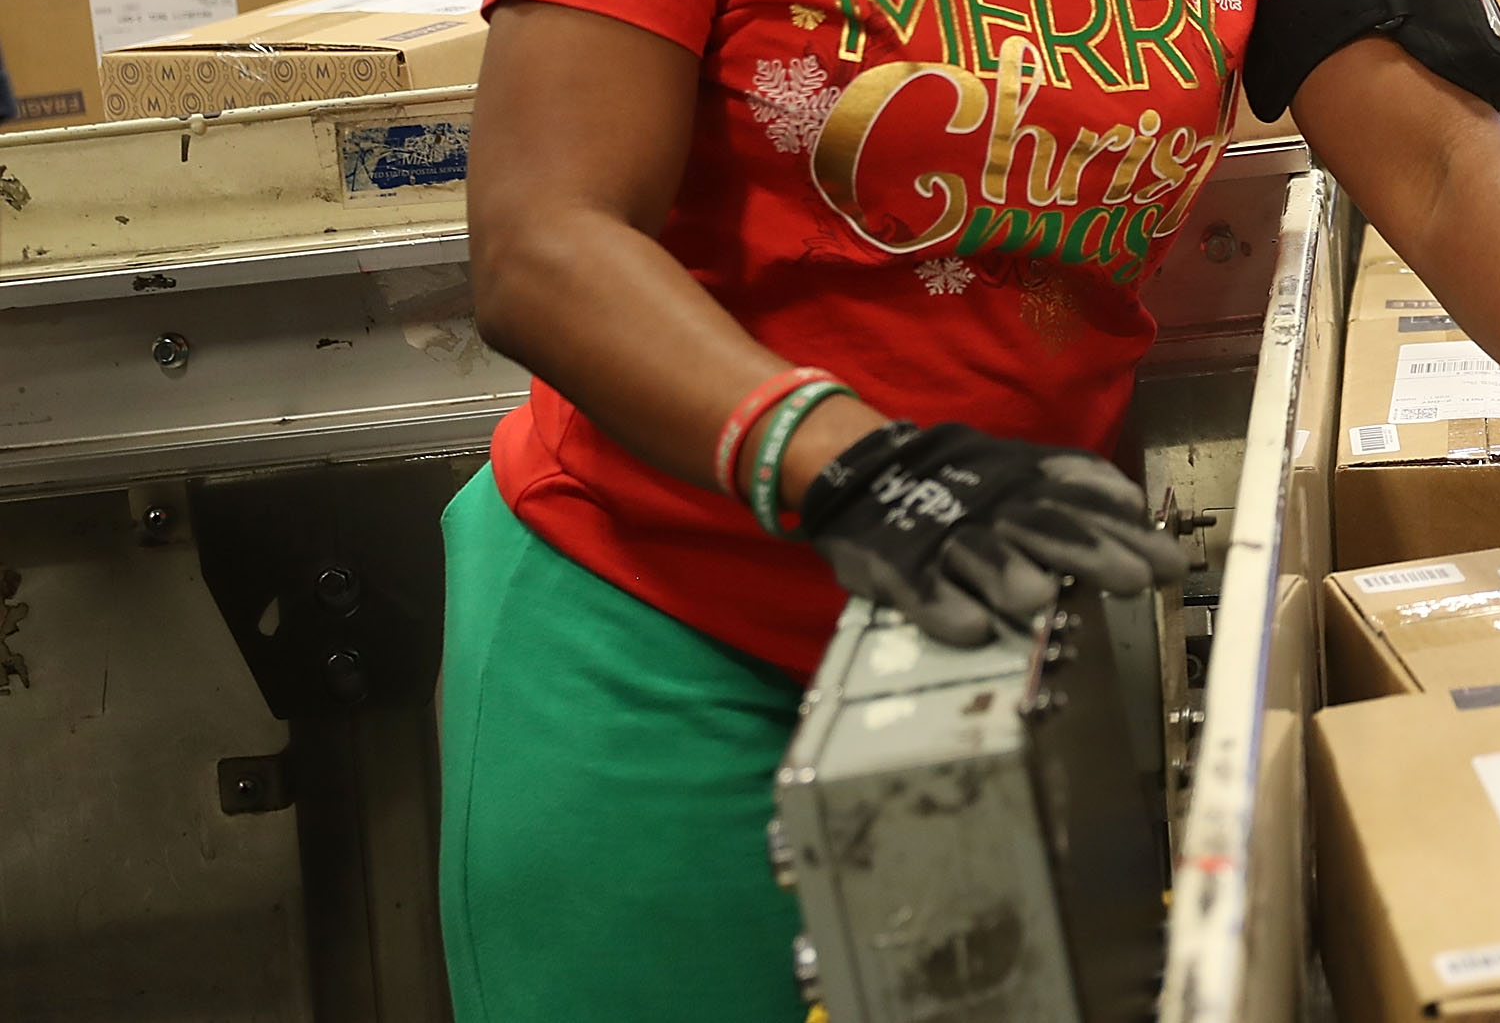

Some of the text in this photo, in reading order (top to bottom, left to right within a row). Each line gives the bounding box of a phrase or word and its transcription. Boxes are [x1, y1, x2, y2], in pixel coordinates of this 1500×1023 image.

[17, 95, 80, 115] FRAGI
[811, 35, 1238, 254] Christ
[955, 203, 1165, 284] mas
